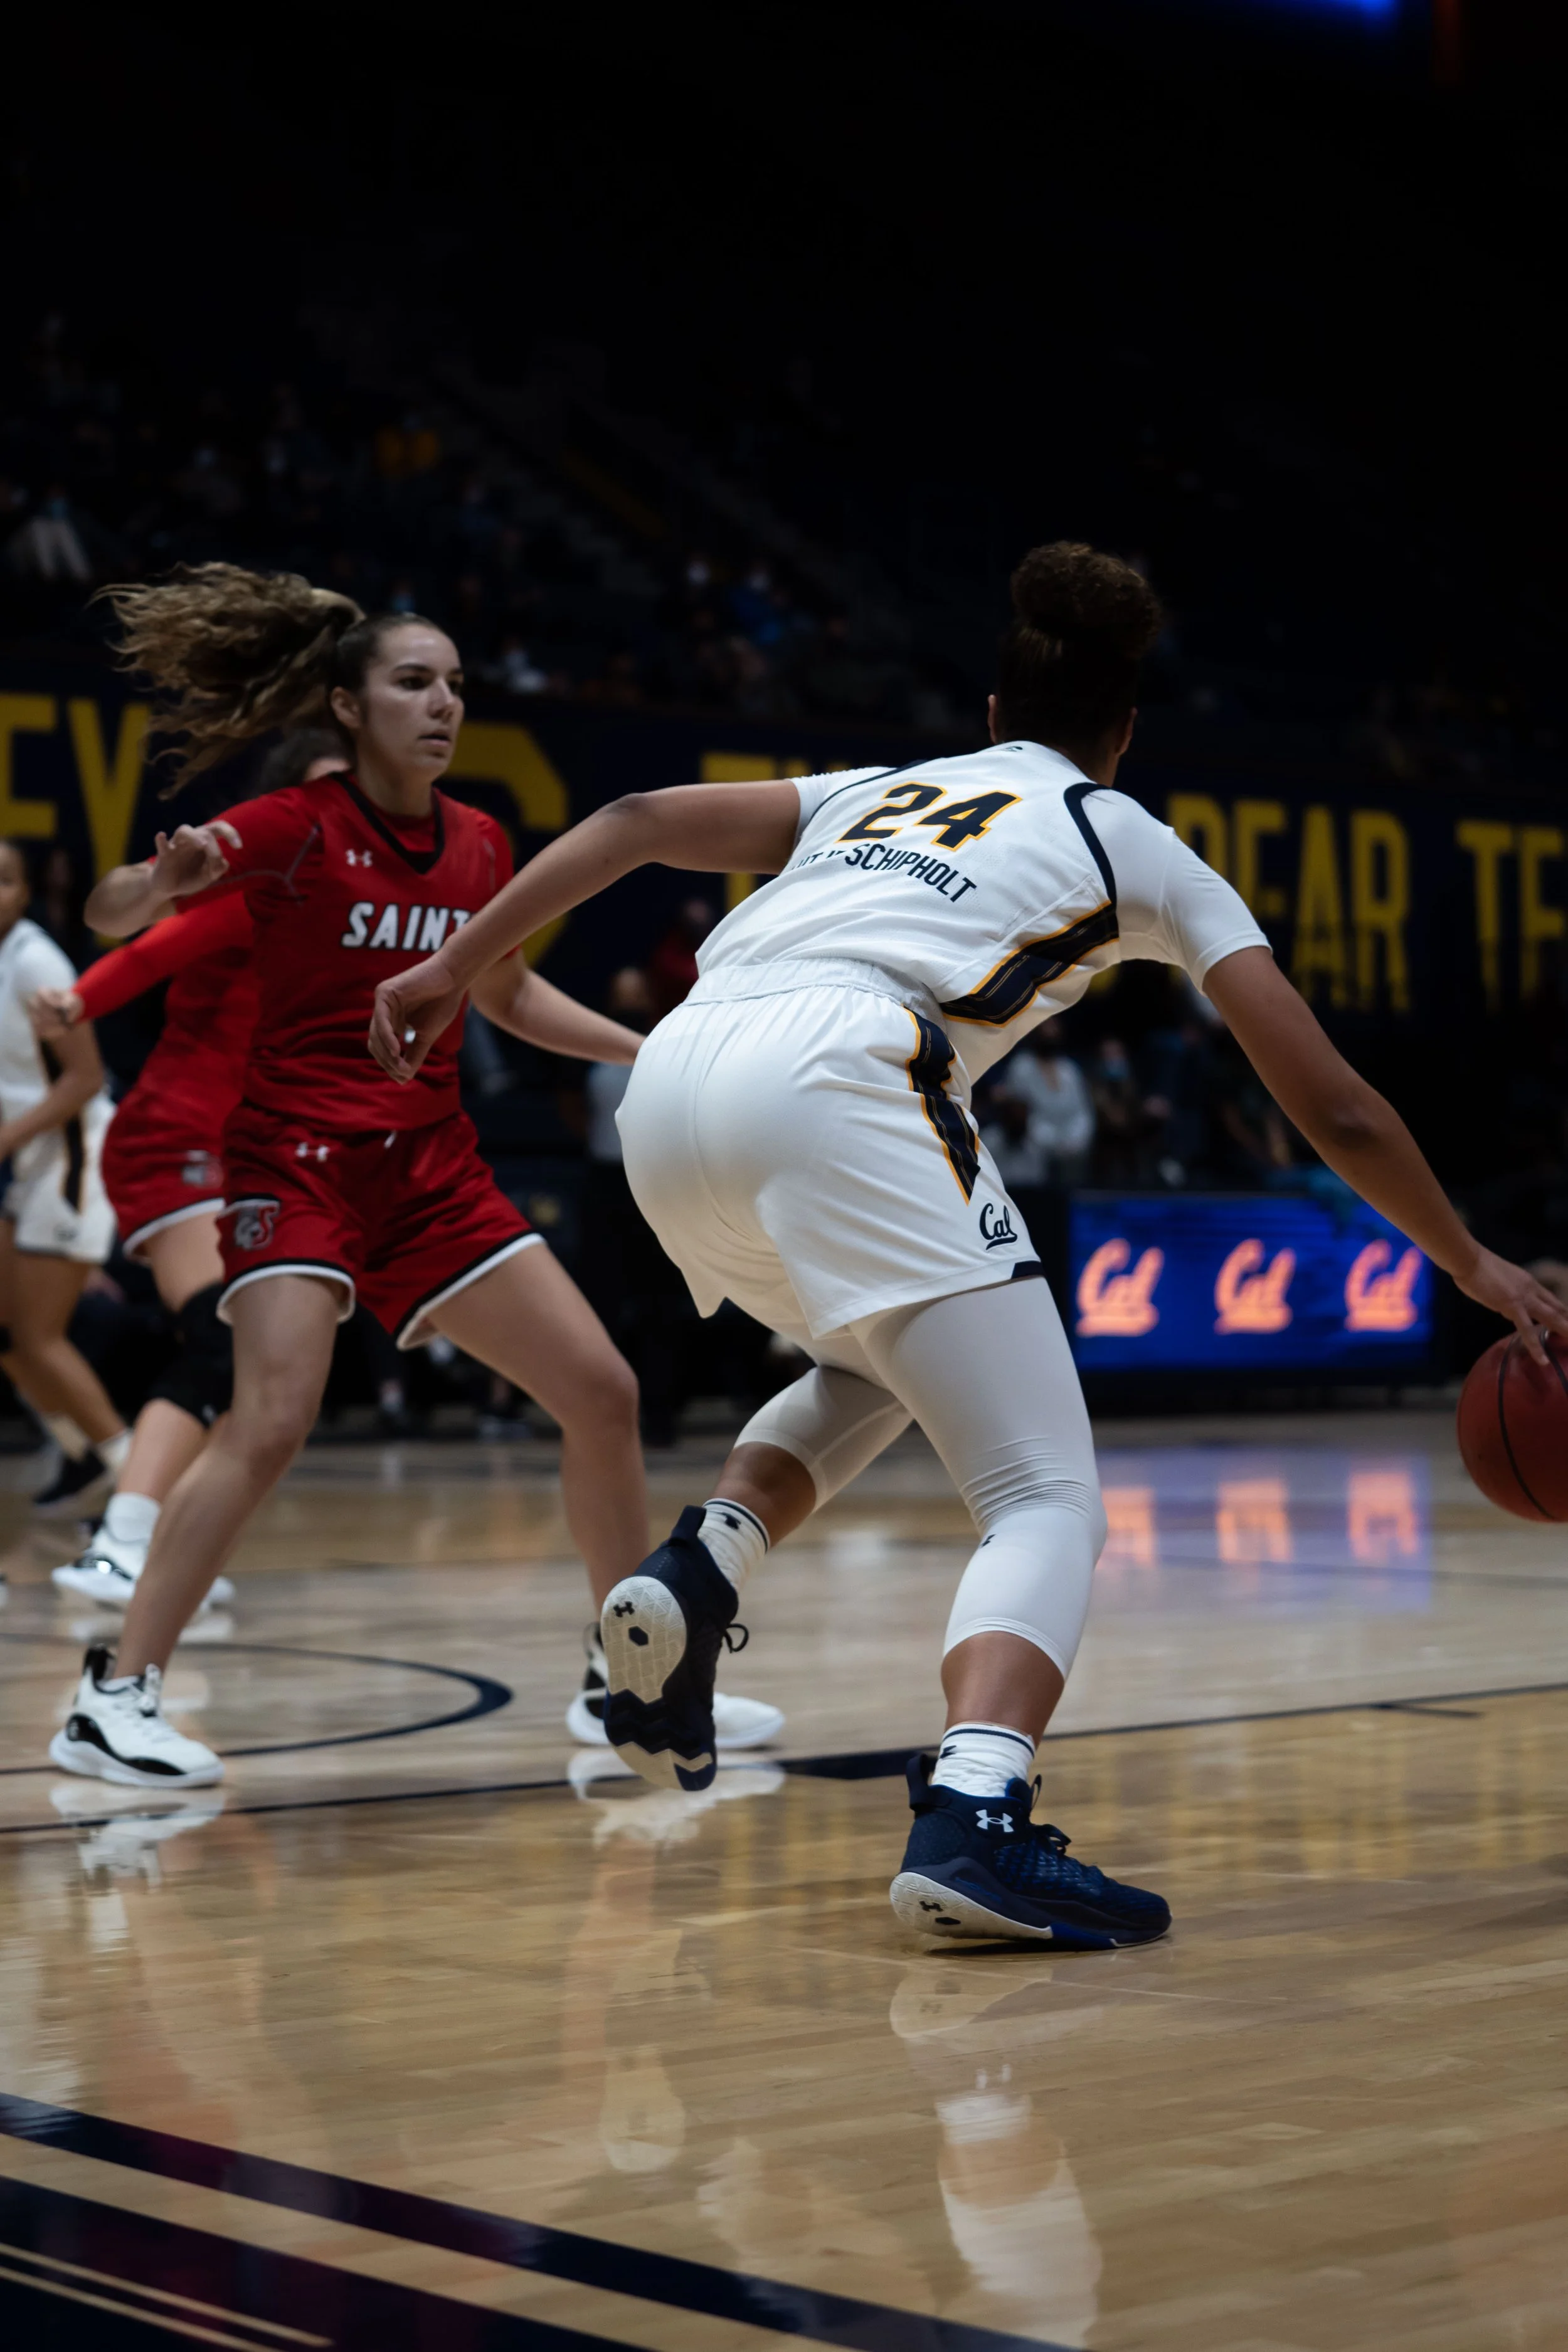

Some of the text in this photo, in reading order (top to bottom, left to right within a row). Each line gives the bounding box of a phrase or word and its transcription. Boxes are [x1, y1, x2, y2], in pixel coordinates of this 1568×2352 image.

[834, 781, 1023, 852] 24
[845, 844, 977, 903] SCHIPHOLT
[980, 1202, 1017, 1250] Cal
